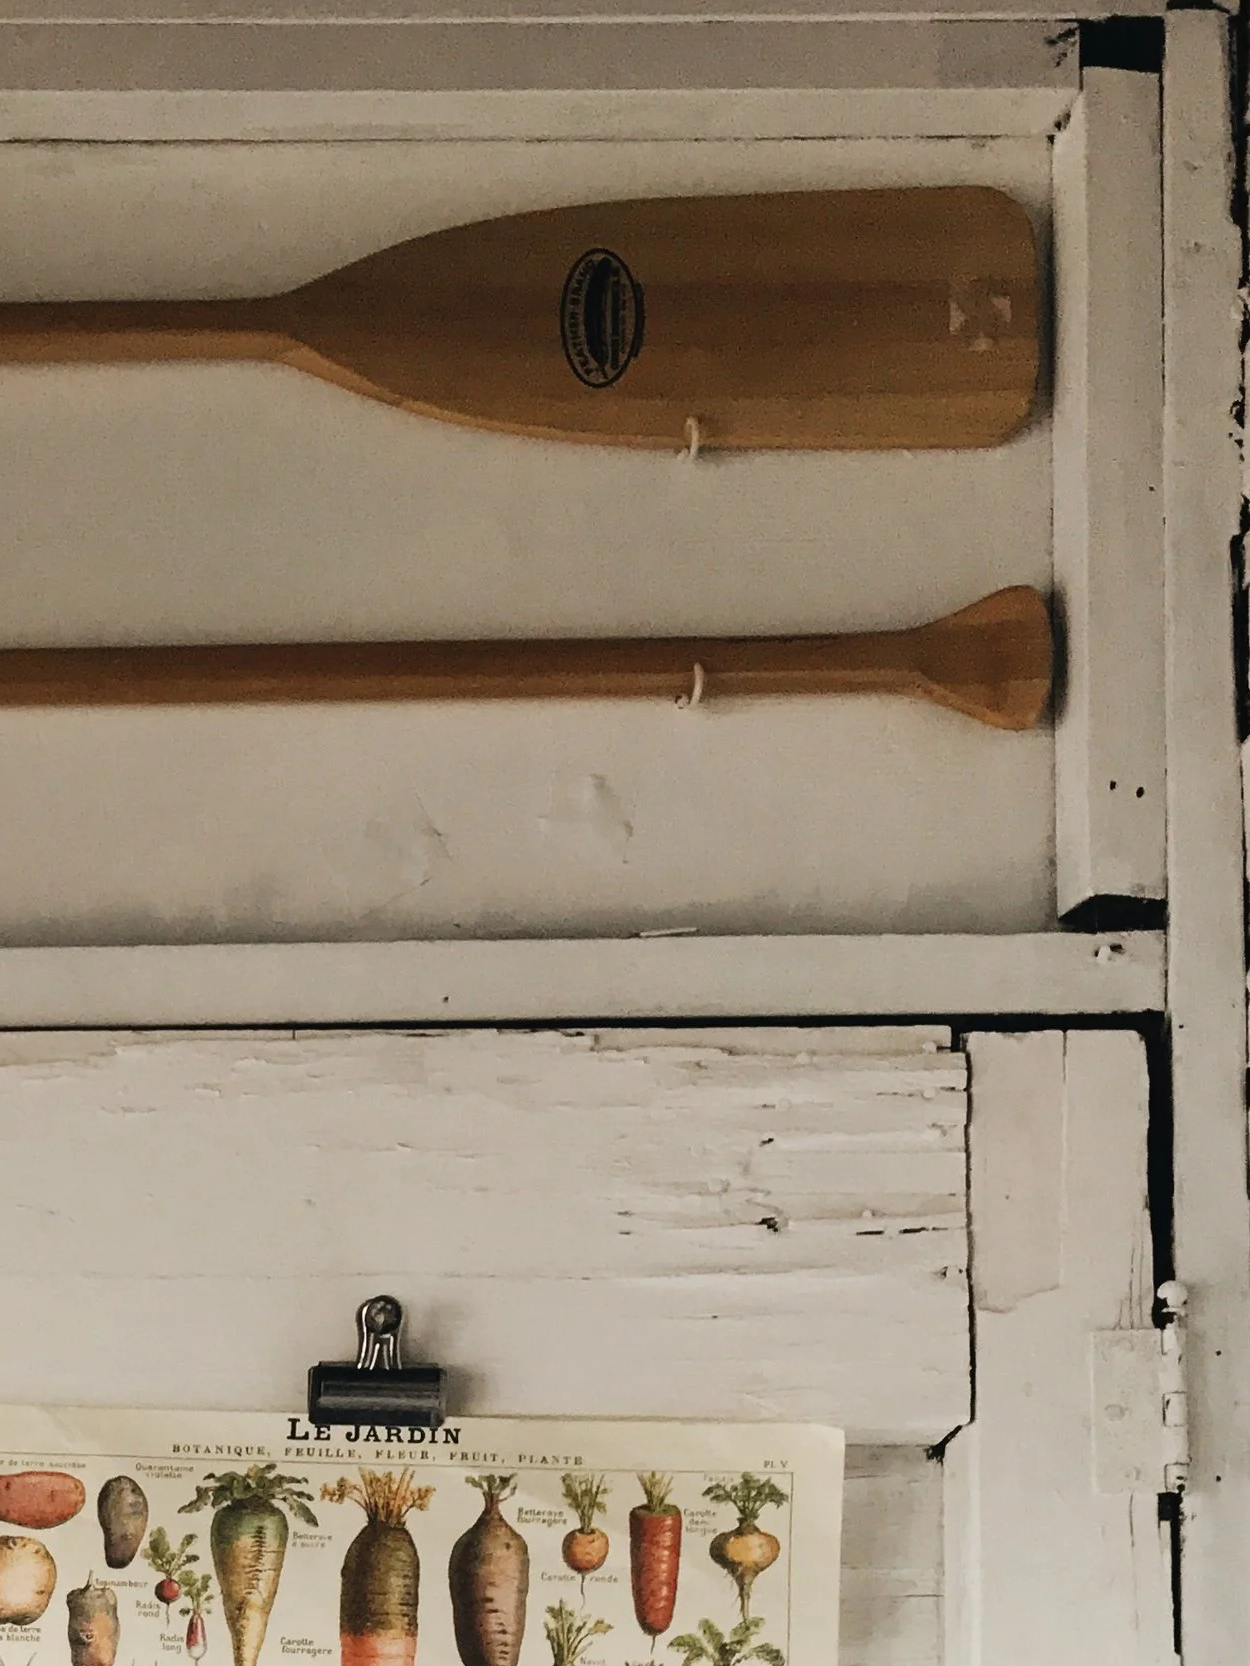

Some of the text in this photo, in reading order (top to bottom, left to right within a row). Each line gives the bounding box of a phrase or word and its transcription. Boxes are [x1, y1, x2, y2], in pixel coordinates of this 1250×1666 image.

[345, 1424, 462, 1444] JARDIN
[172, 1443, 584, 1466] BOTANIQUE, FEUILLE, FLEUR, FRUIT, PLANTE
